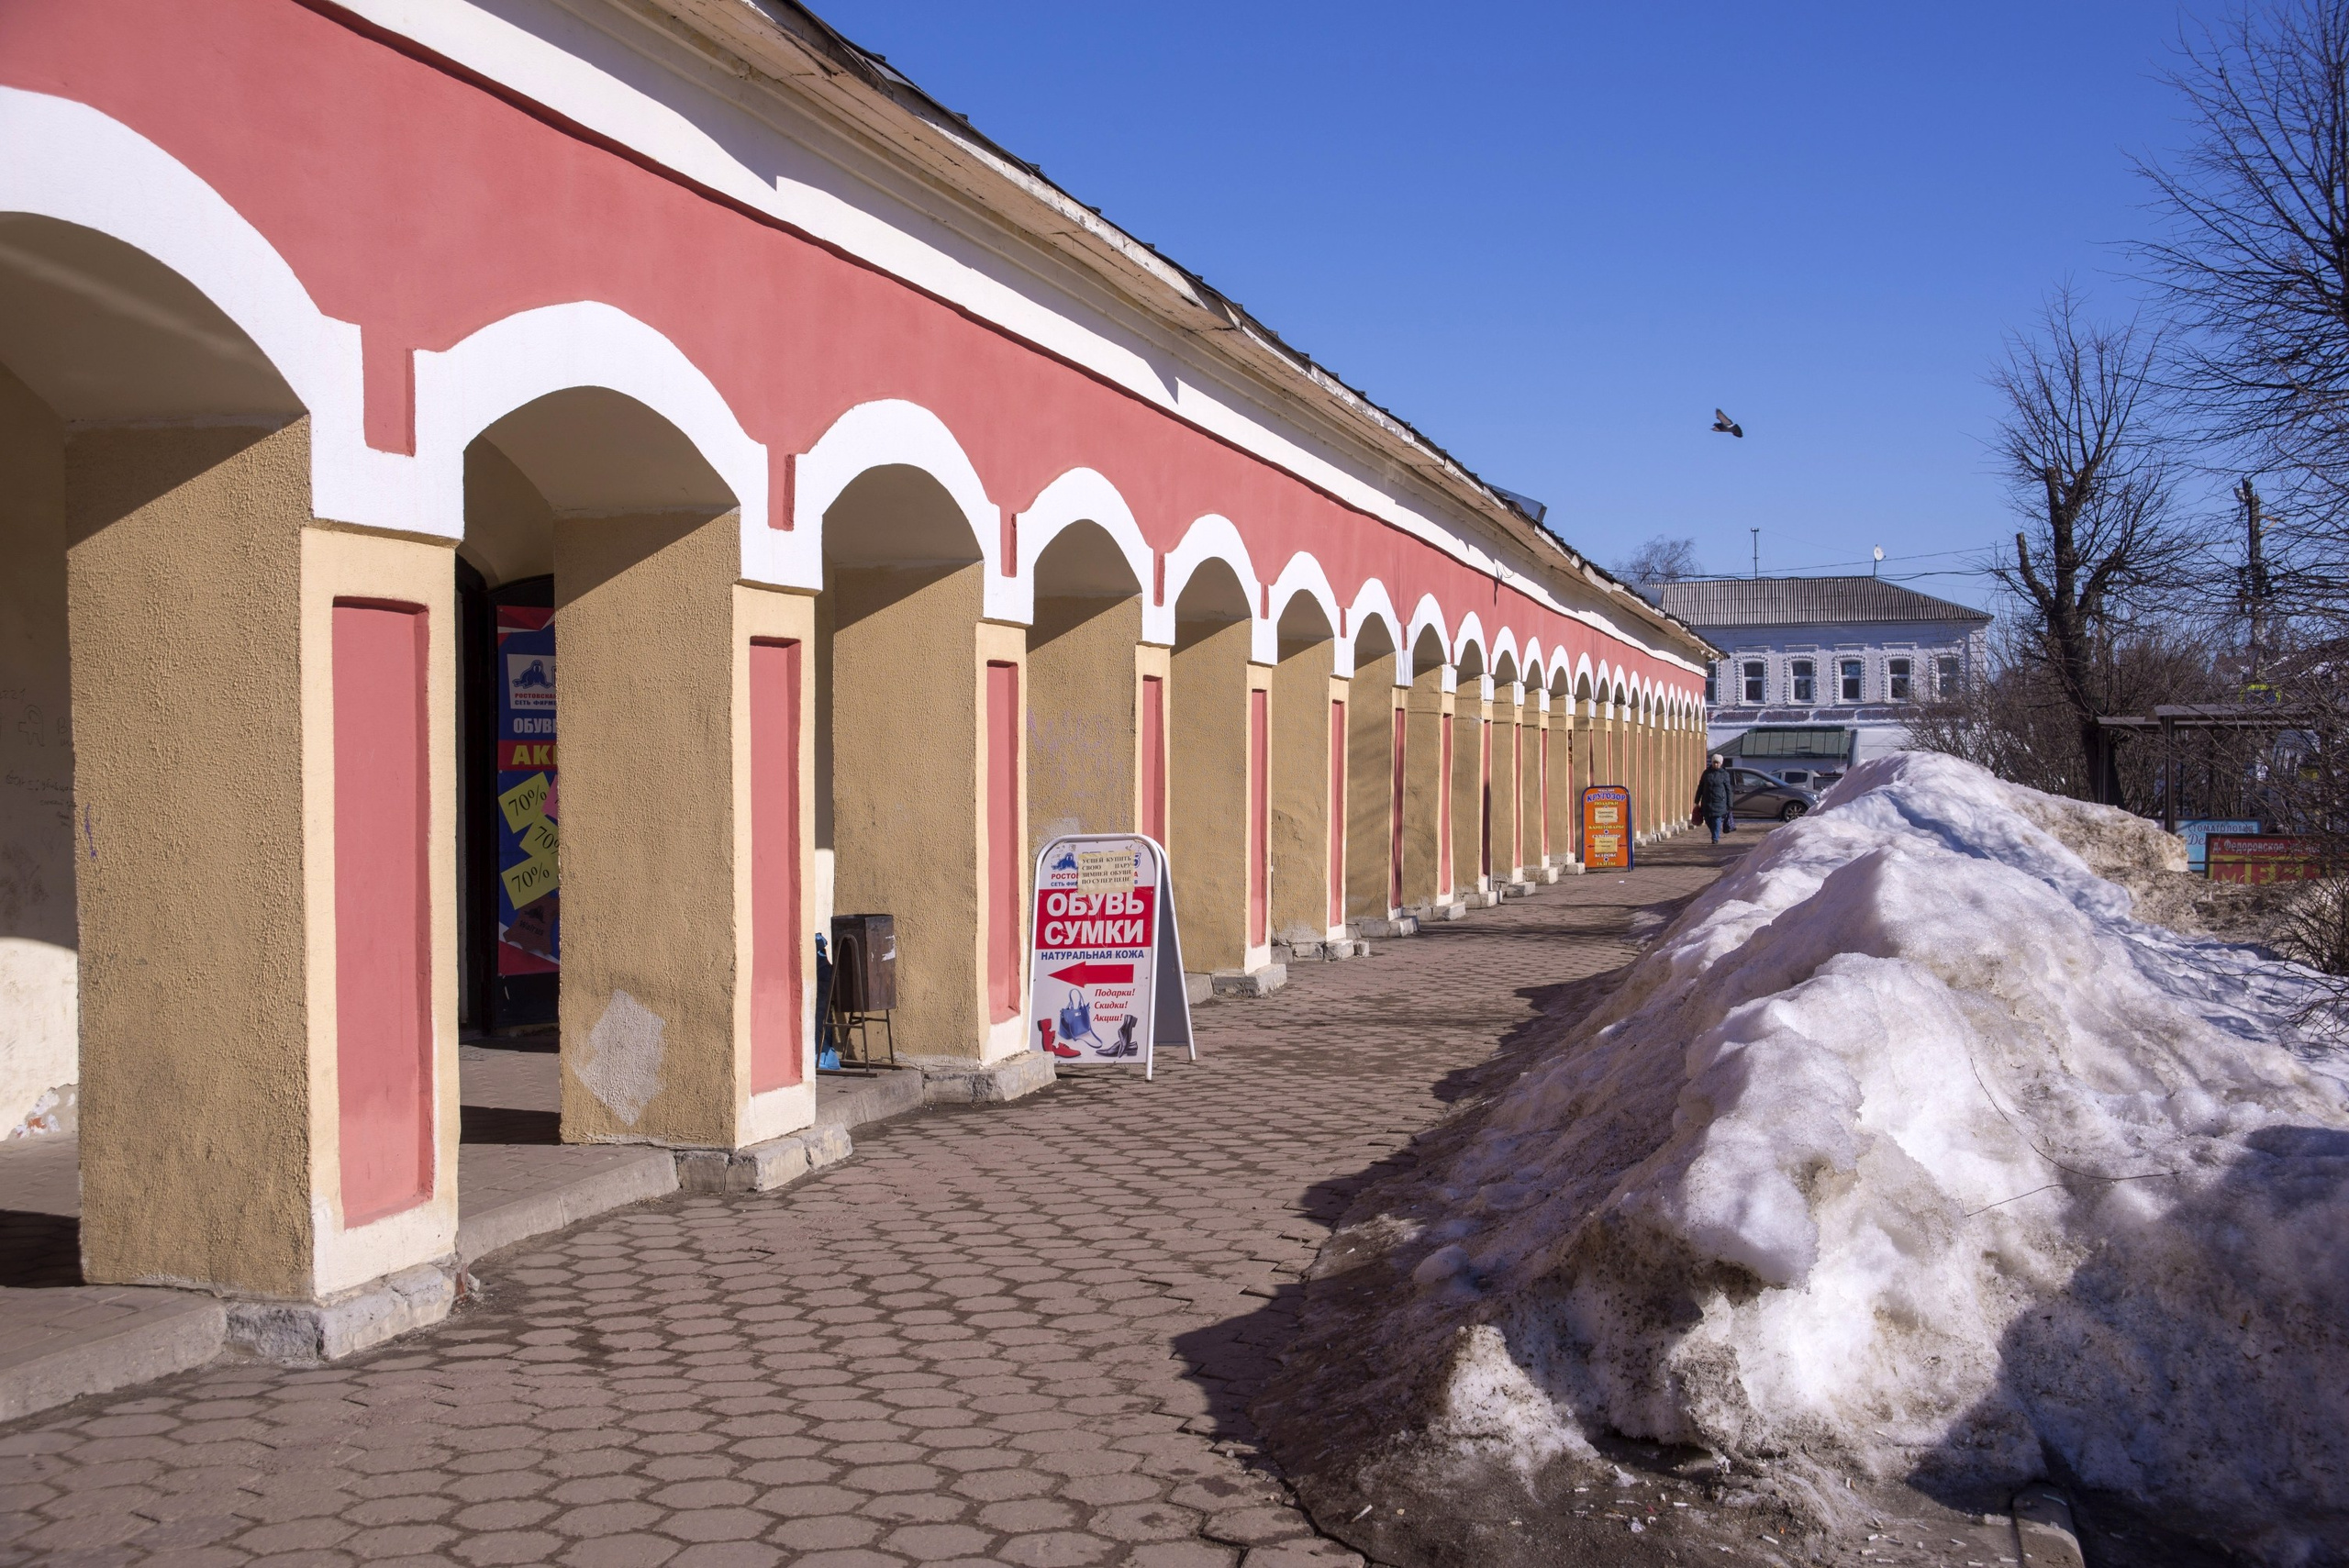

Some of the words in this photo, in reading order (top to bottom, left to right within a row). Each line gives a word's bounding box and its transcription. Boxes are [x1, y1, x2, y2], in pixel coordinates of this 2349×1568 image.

[508, 784, 547, 817] 70%
[1586, 792, 1627, 803] КРУГОЗОР
[511, 862, 550, 893] 70%
[1046, 892, 1145, 917] ОБУВЬ
[1044, 918, 1143, 945] СУМКИ
[1041, 951, 1113, 961] НАТУРАЛЬНАЯ
[1115, 950, 1145, 959] КОЖА
[1095, 988, 1136, 997] Подарки!
[1094, 1001, 1129, 1010] Скидки!
[1093, 1014, 1123, 1023] Акции!
